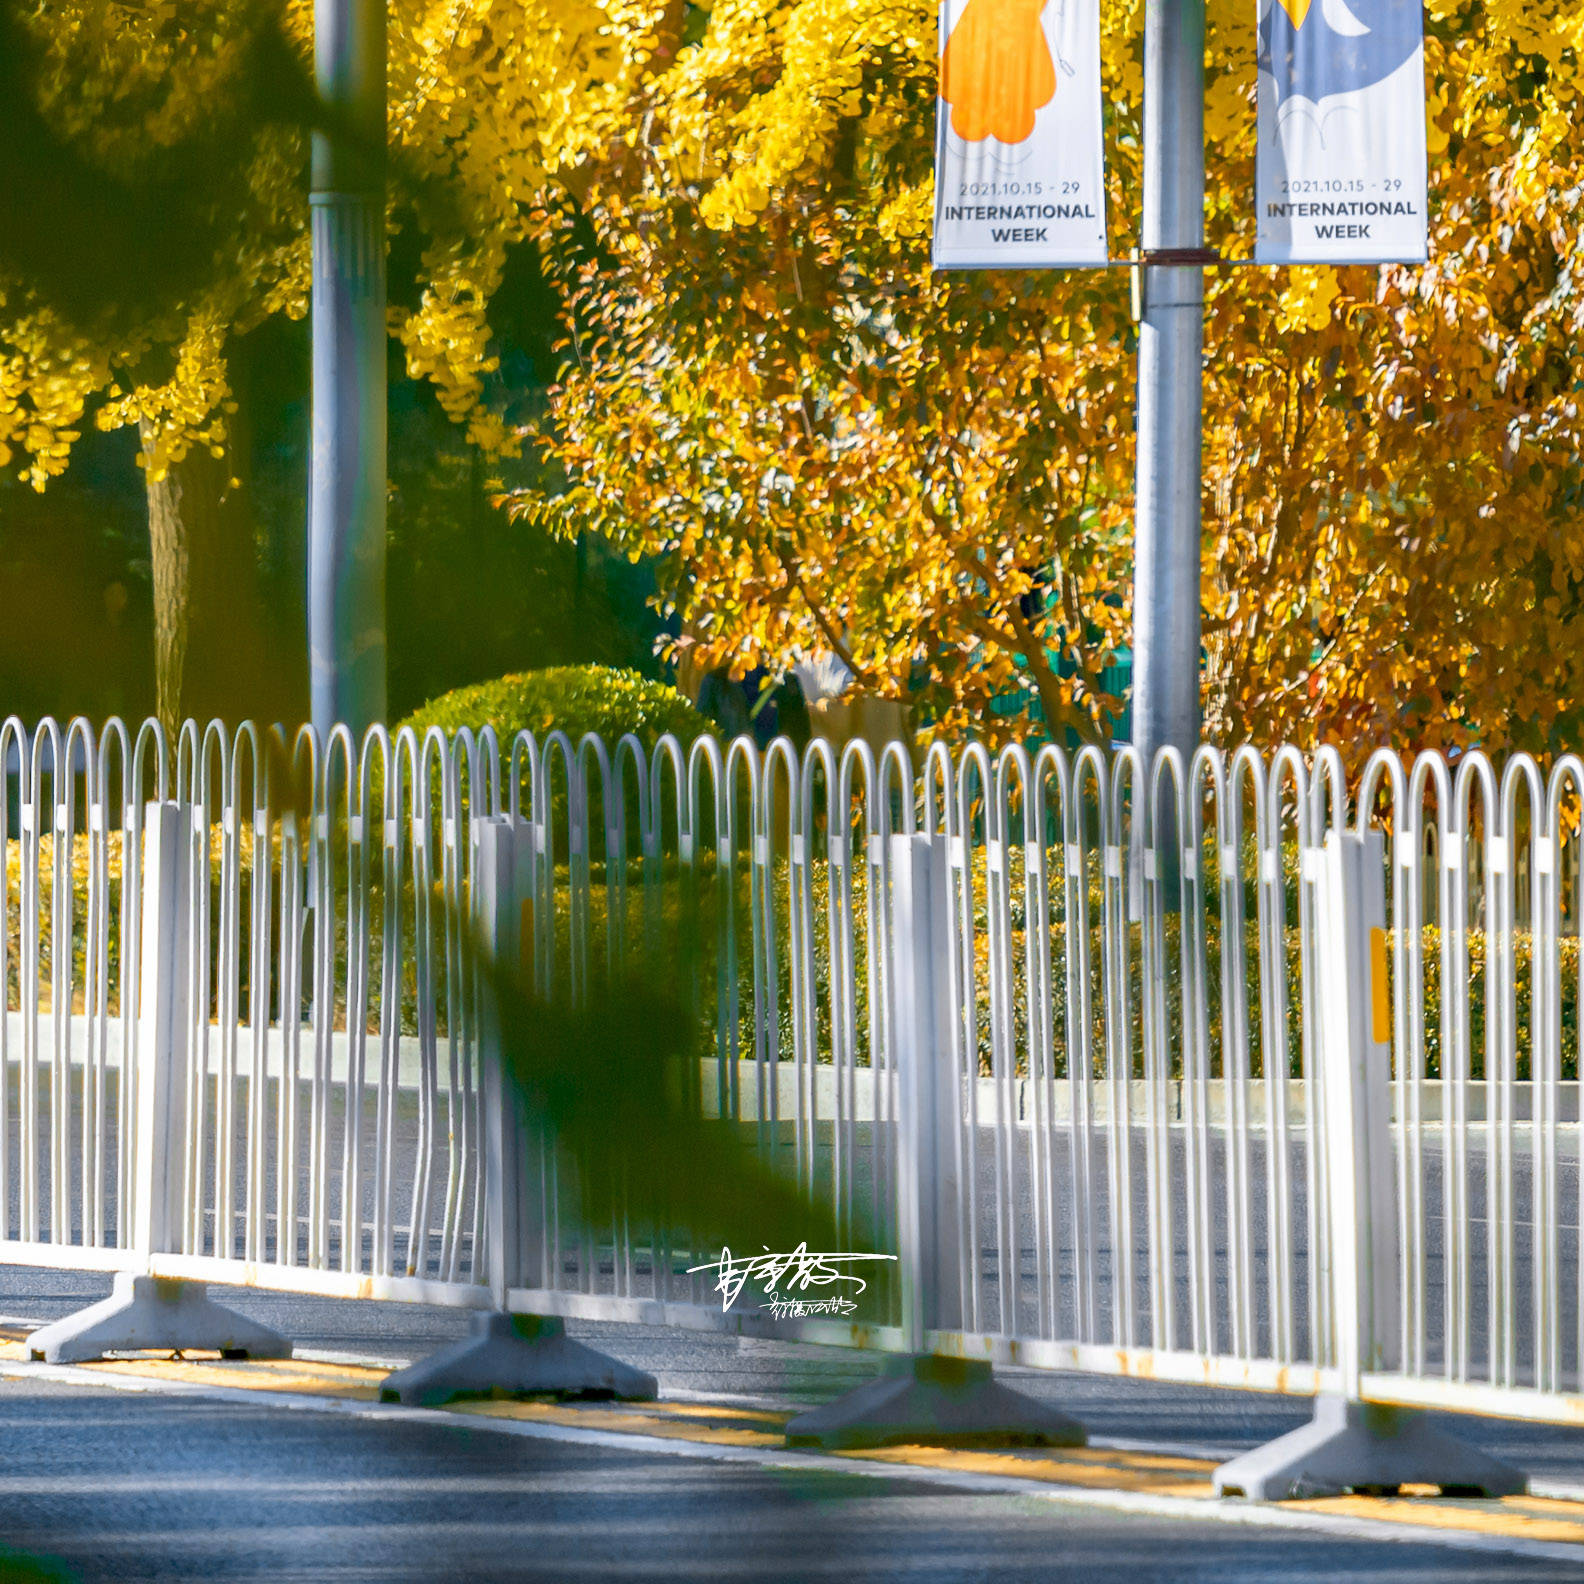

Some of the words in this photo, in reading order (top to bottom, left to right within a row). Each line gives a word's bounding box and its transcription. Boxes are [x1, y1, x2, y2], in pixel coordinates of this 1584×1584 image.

[959, 182, 1043, 196] 2021.10.15
[1062, 181, 1080, 195] 29
[1281, 180, 1365, 194] 2021.10.15
[1383, 179, 1402, 192] 29
[945, 204, 1096, 220] INTERNATIONAL
[1267, 201, 1417, 217] INTERNATIONAL
[991, 227, 1048, 242] WEEK
[1315, 224, 1371, 239] WEEK
